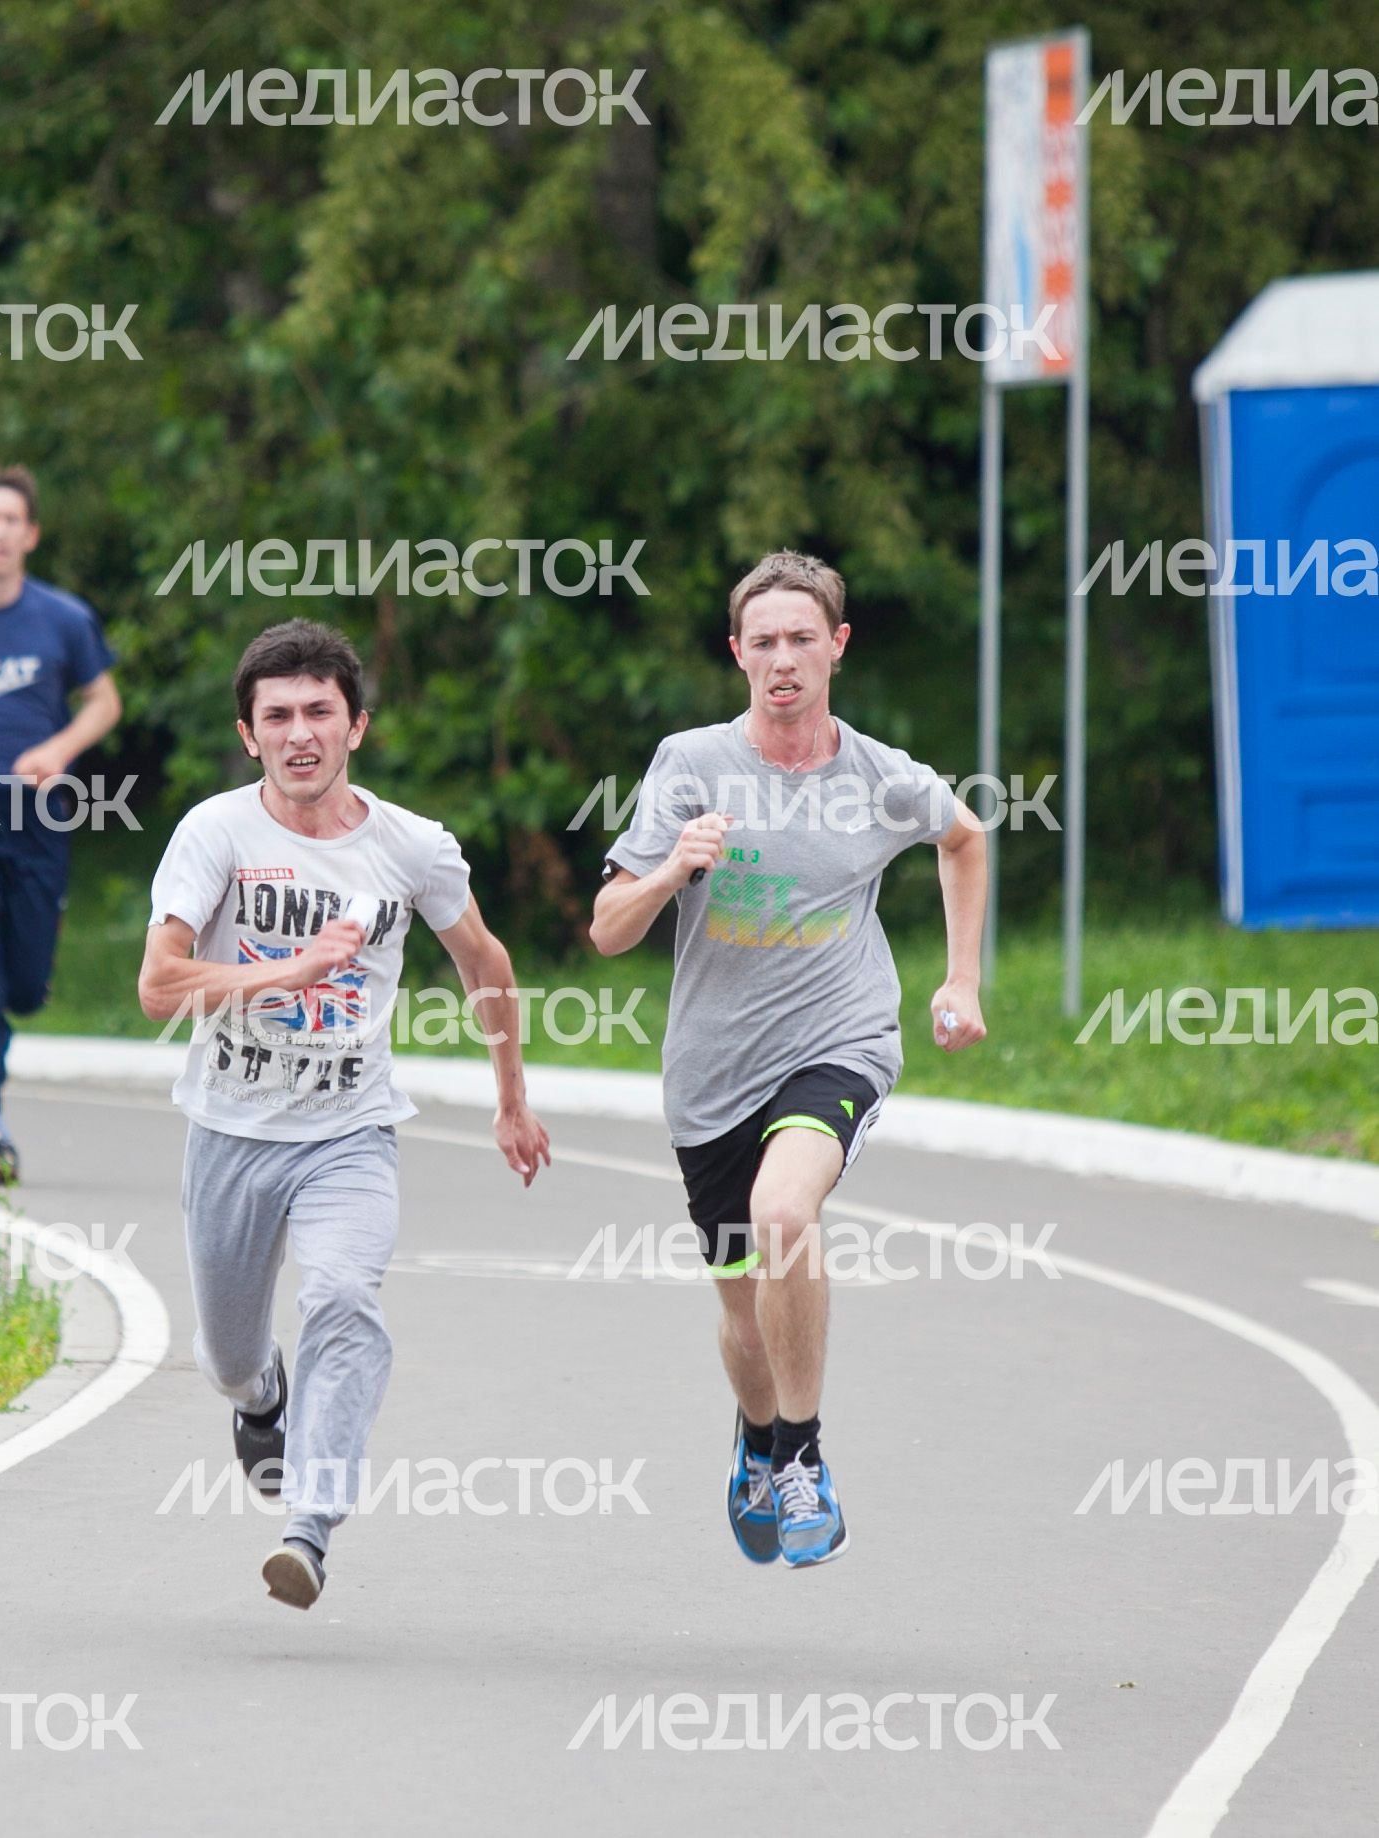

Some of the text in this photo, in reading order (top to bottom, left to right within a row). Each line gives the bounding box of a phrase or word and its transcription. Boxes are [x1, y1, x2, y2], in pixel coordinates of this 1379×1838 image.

[235, 880, 399, 946] LONDN
[709, 868, 799, 912] GET
[205, 1031, 364, 1093] STYLE
